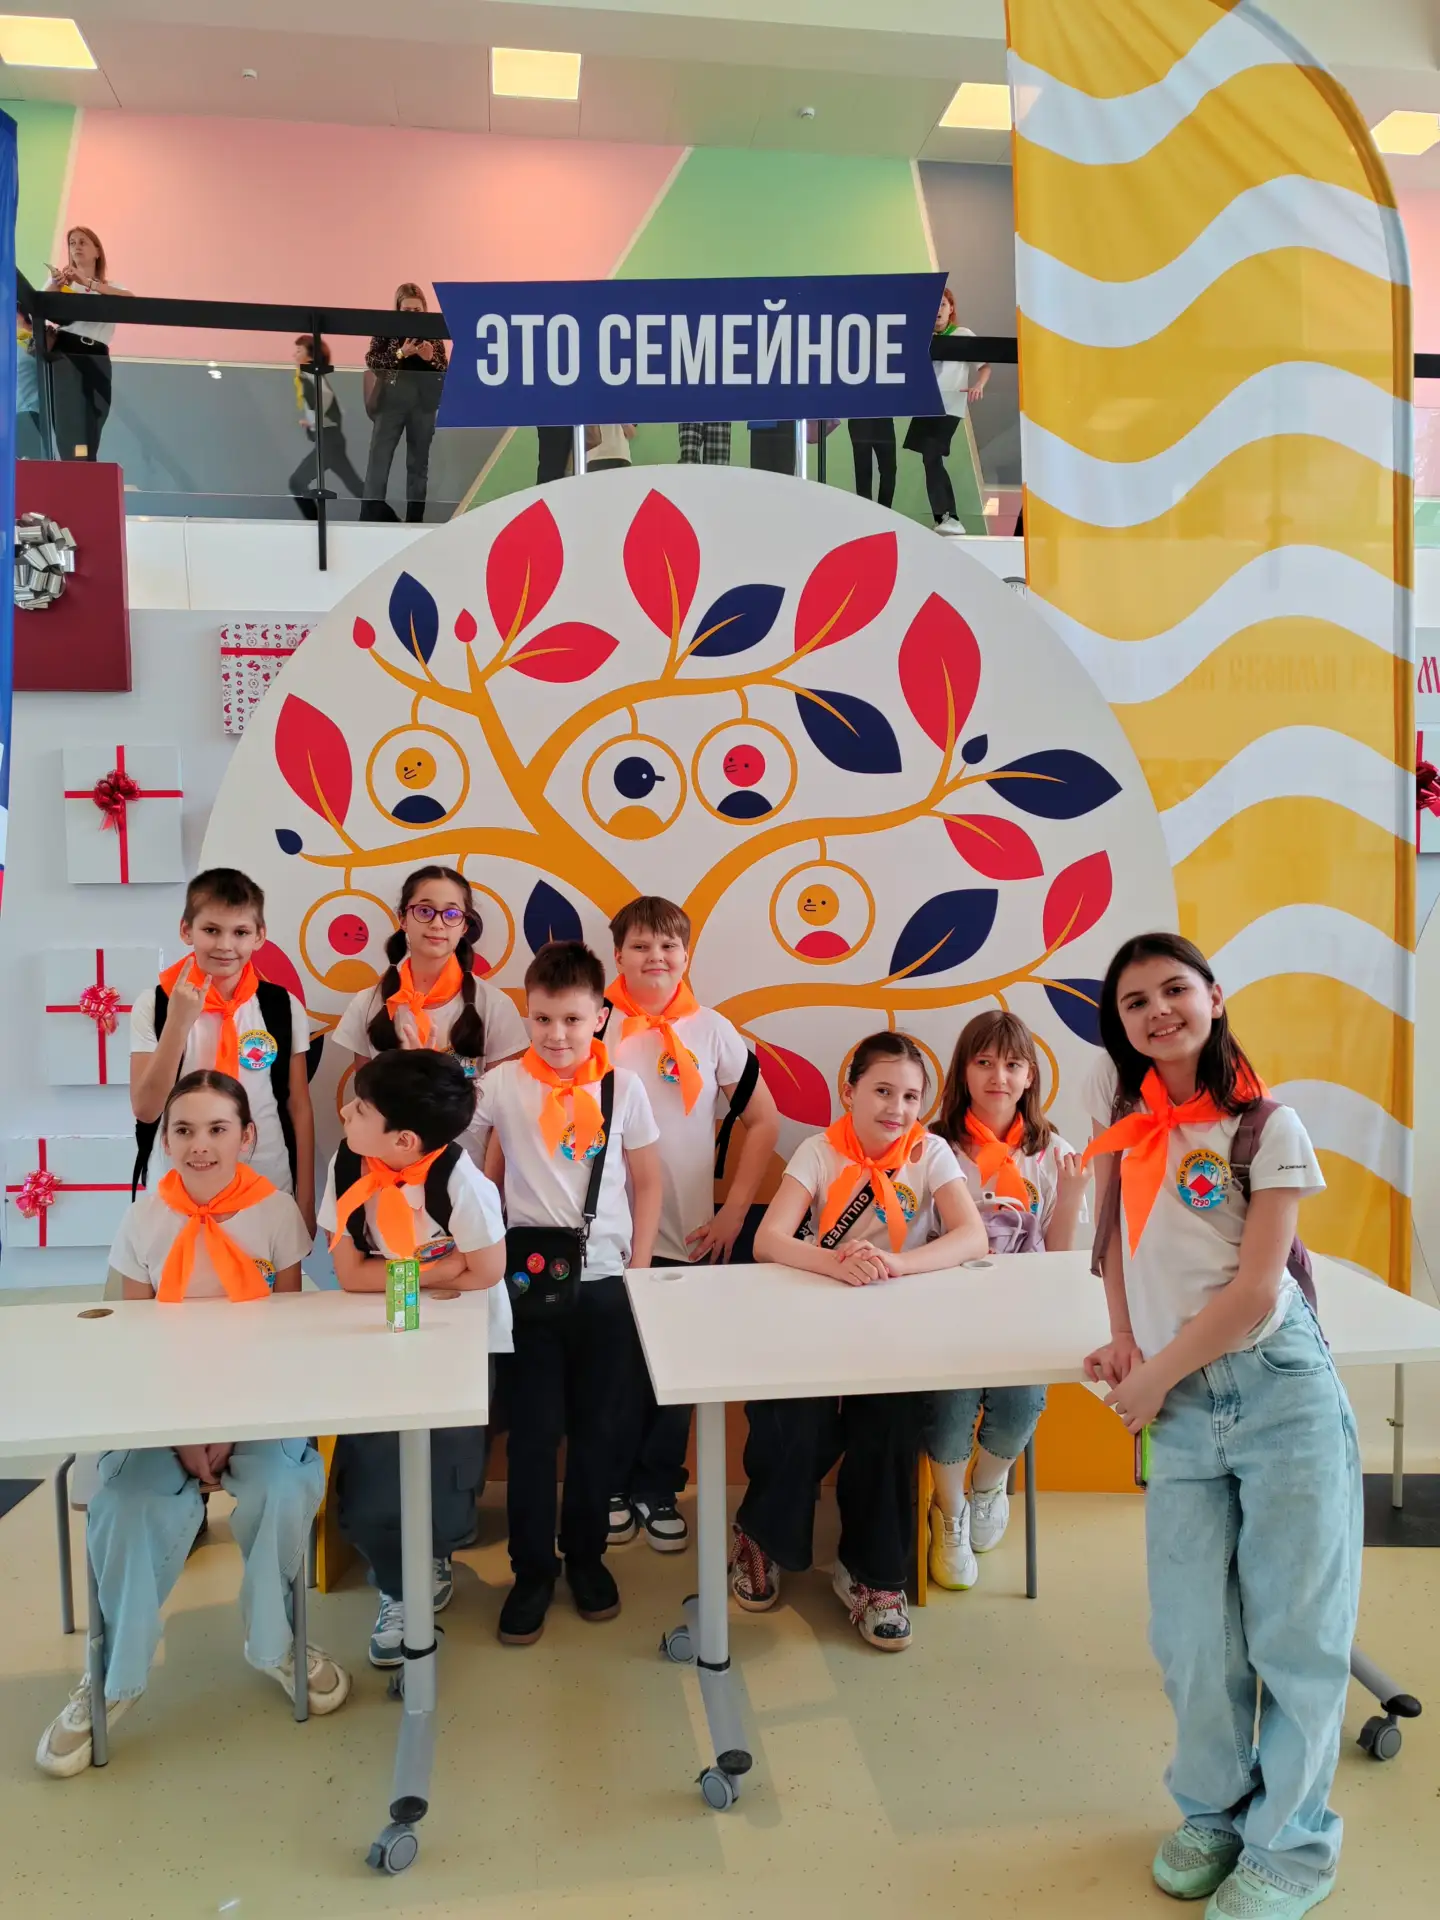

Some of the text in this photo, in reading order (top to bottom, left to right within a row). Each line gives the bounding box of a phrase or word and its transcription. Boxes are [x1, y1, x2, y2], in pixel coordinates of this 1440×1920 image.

[476, 298, 907, 387] ЭТО СЕМЕЙНОЕ
[822, 1192, 870, 1247] GULLIVER
